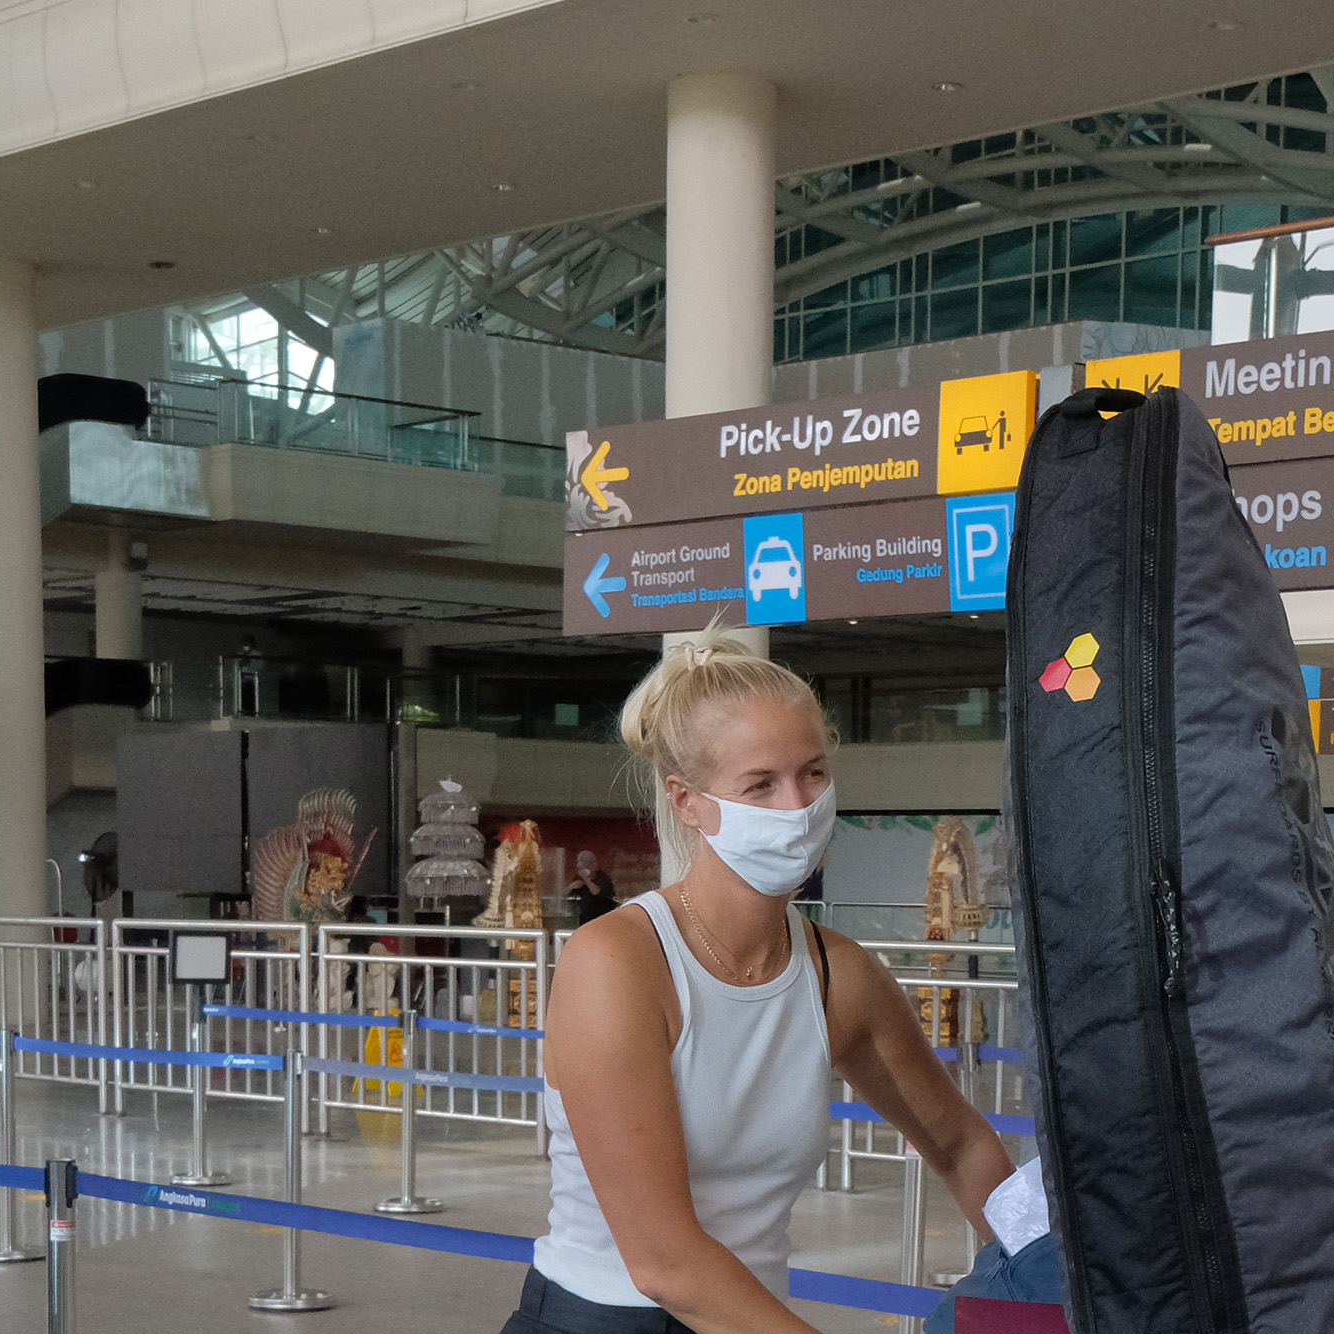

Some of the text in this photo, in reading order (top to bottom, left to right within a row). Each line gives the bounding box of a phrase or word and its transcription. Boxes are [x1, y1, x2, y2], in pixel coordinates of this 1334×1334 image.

[720, 408, 920, 458] Pick-Up Zone
[1208, 411, 1296, 446] Tempat
[733, 458, 919, 497] Zona Penjemputan
[631, 542, 730, 569] Airport Ground
[813, 536, 942, 562] Parking Building
[631, 567, 695, 588] Transport
[857, 563, 943, 583] Gedung Parkir
[631, 586, 745, 608] Transportasi Bandara
